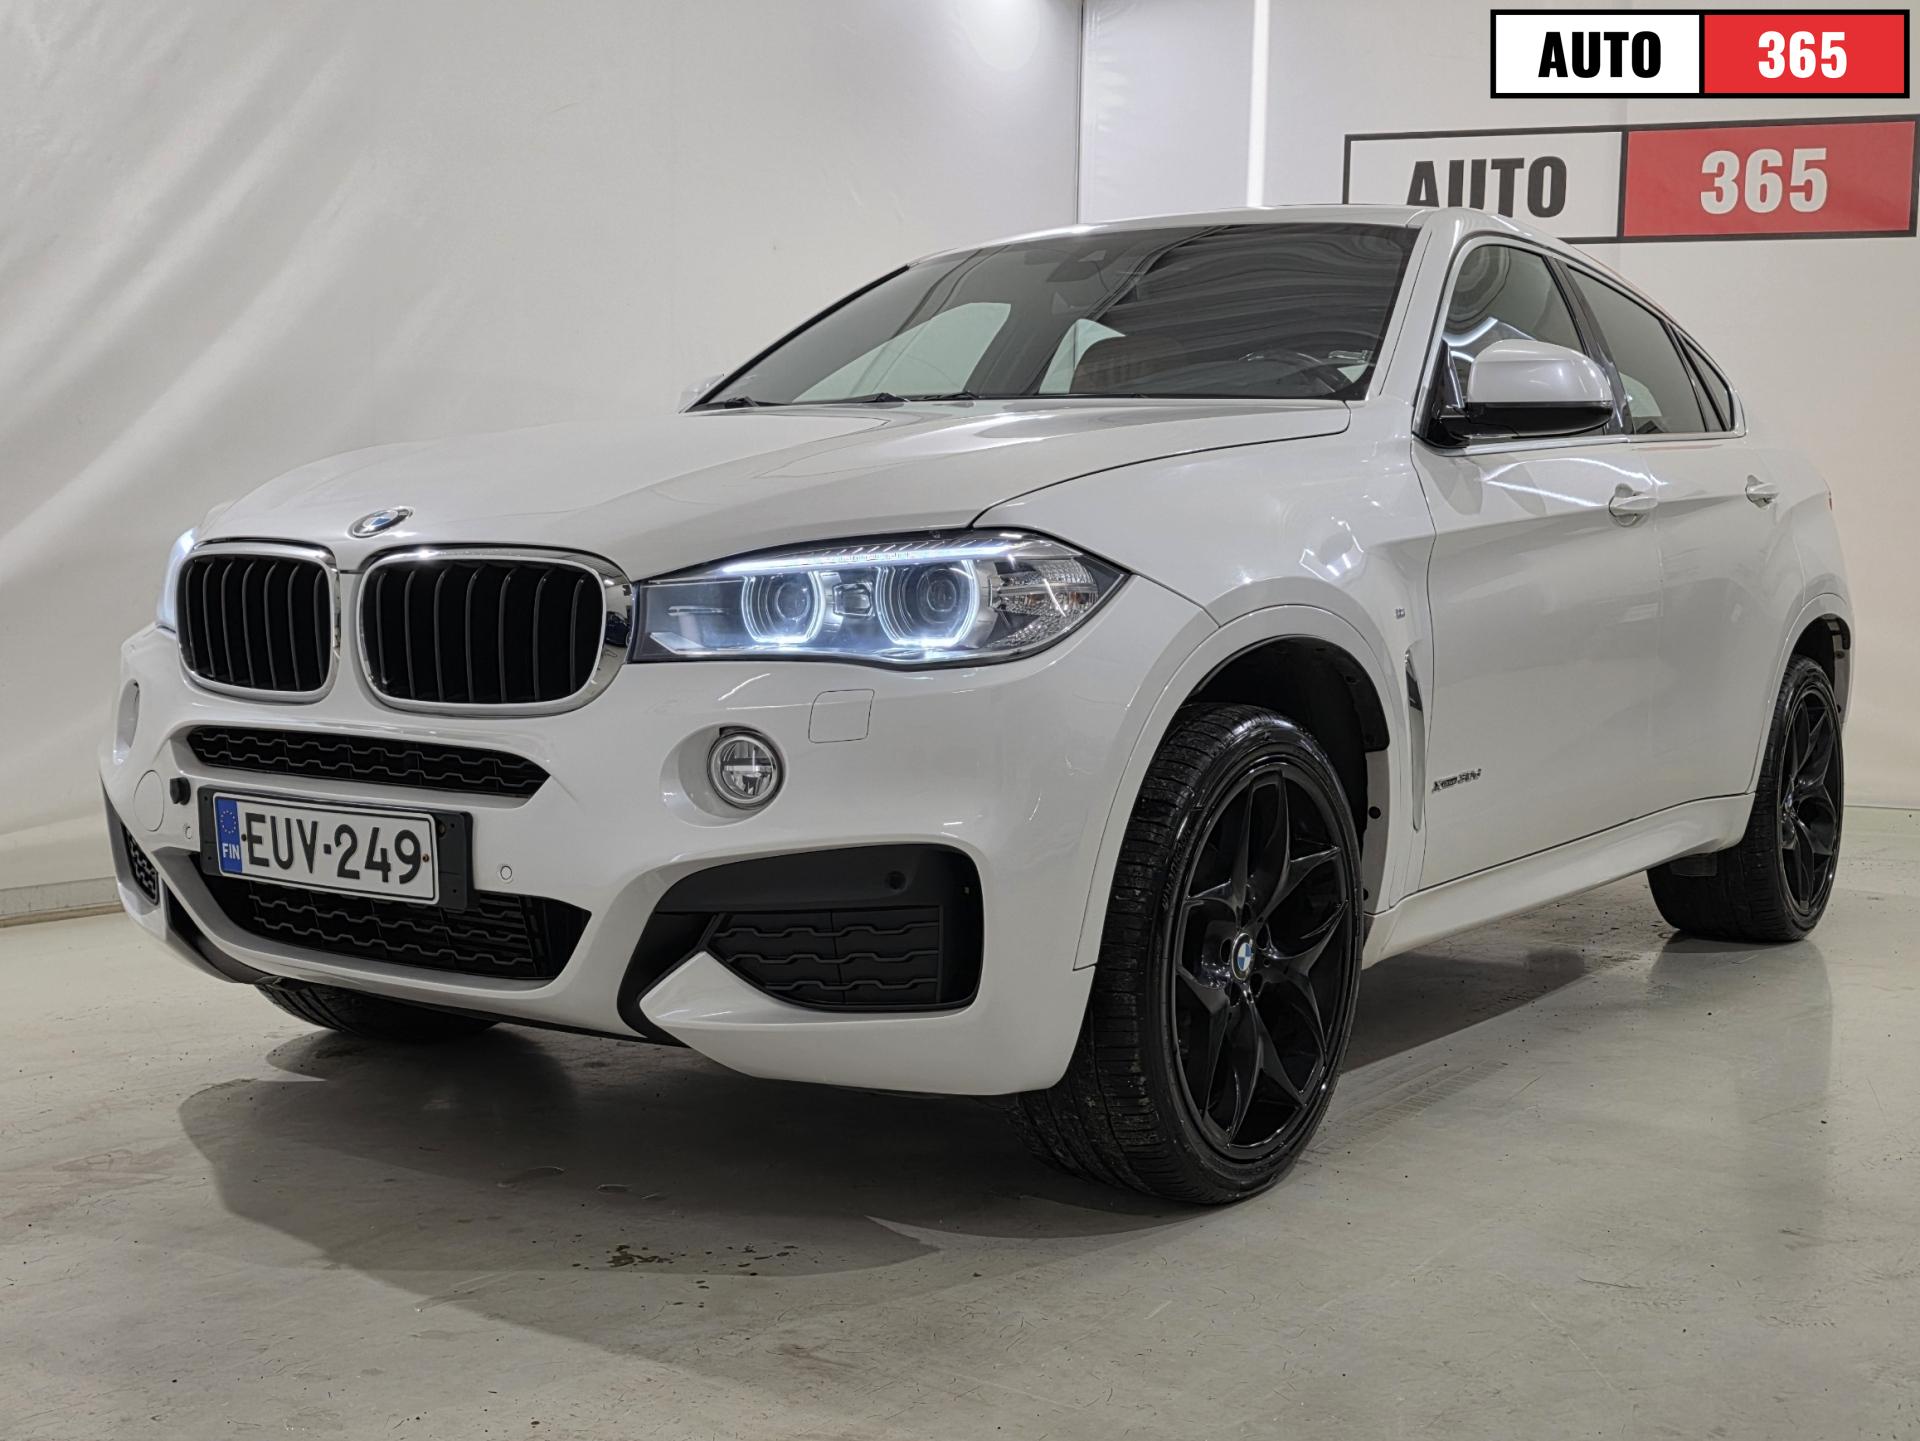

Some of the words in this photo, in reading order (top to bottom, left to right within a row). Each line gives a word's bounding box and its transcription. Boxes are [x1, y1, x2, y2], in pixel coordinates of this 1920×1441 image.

[1405, 155, 1567, 218] AUTO
[1700, 147, 1829, 215] 365
[221, 842, 241, 861] FIN
[245, 812, 421, 885] EUV-249
